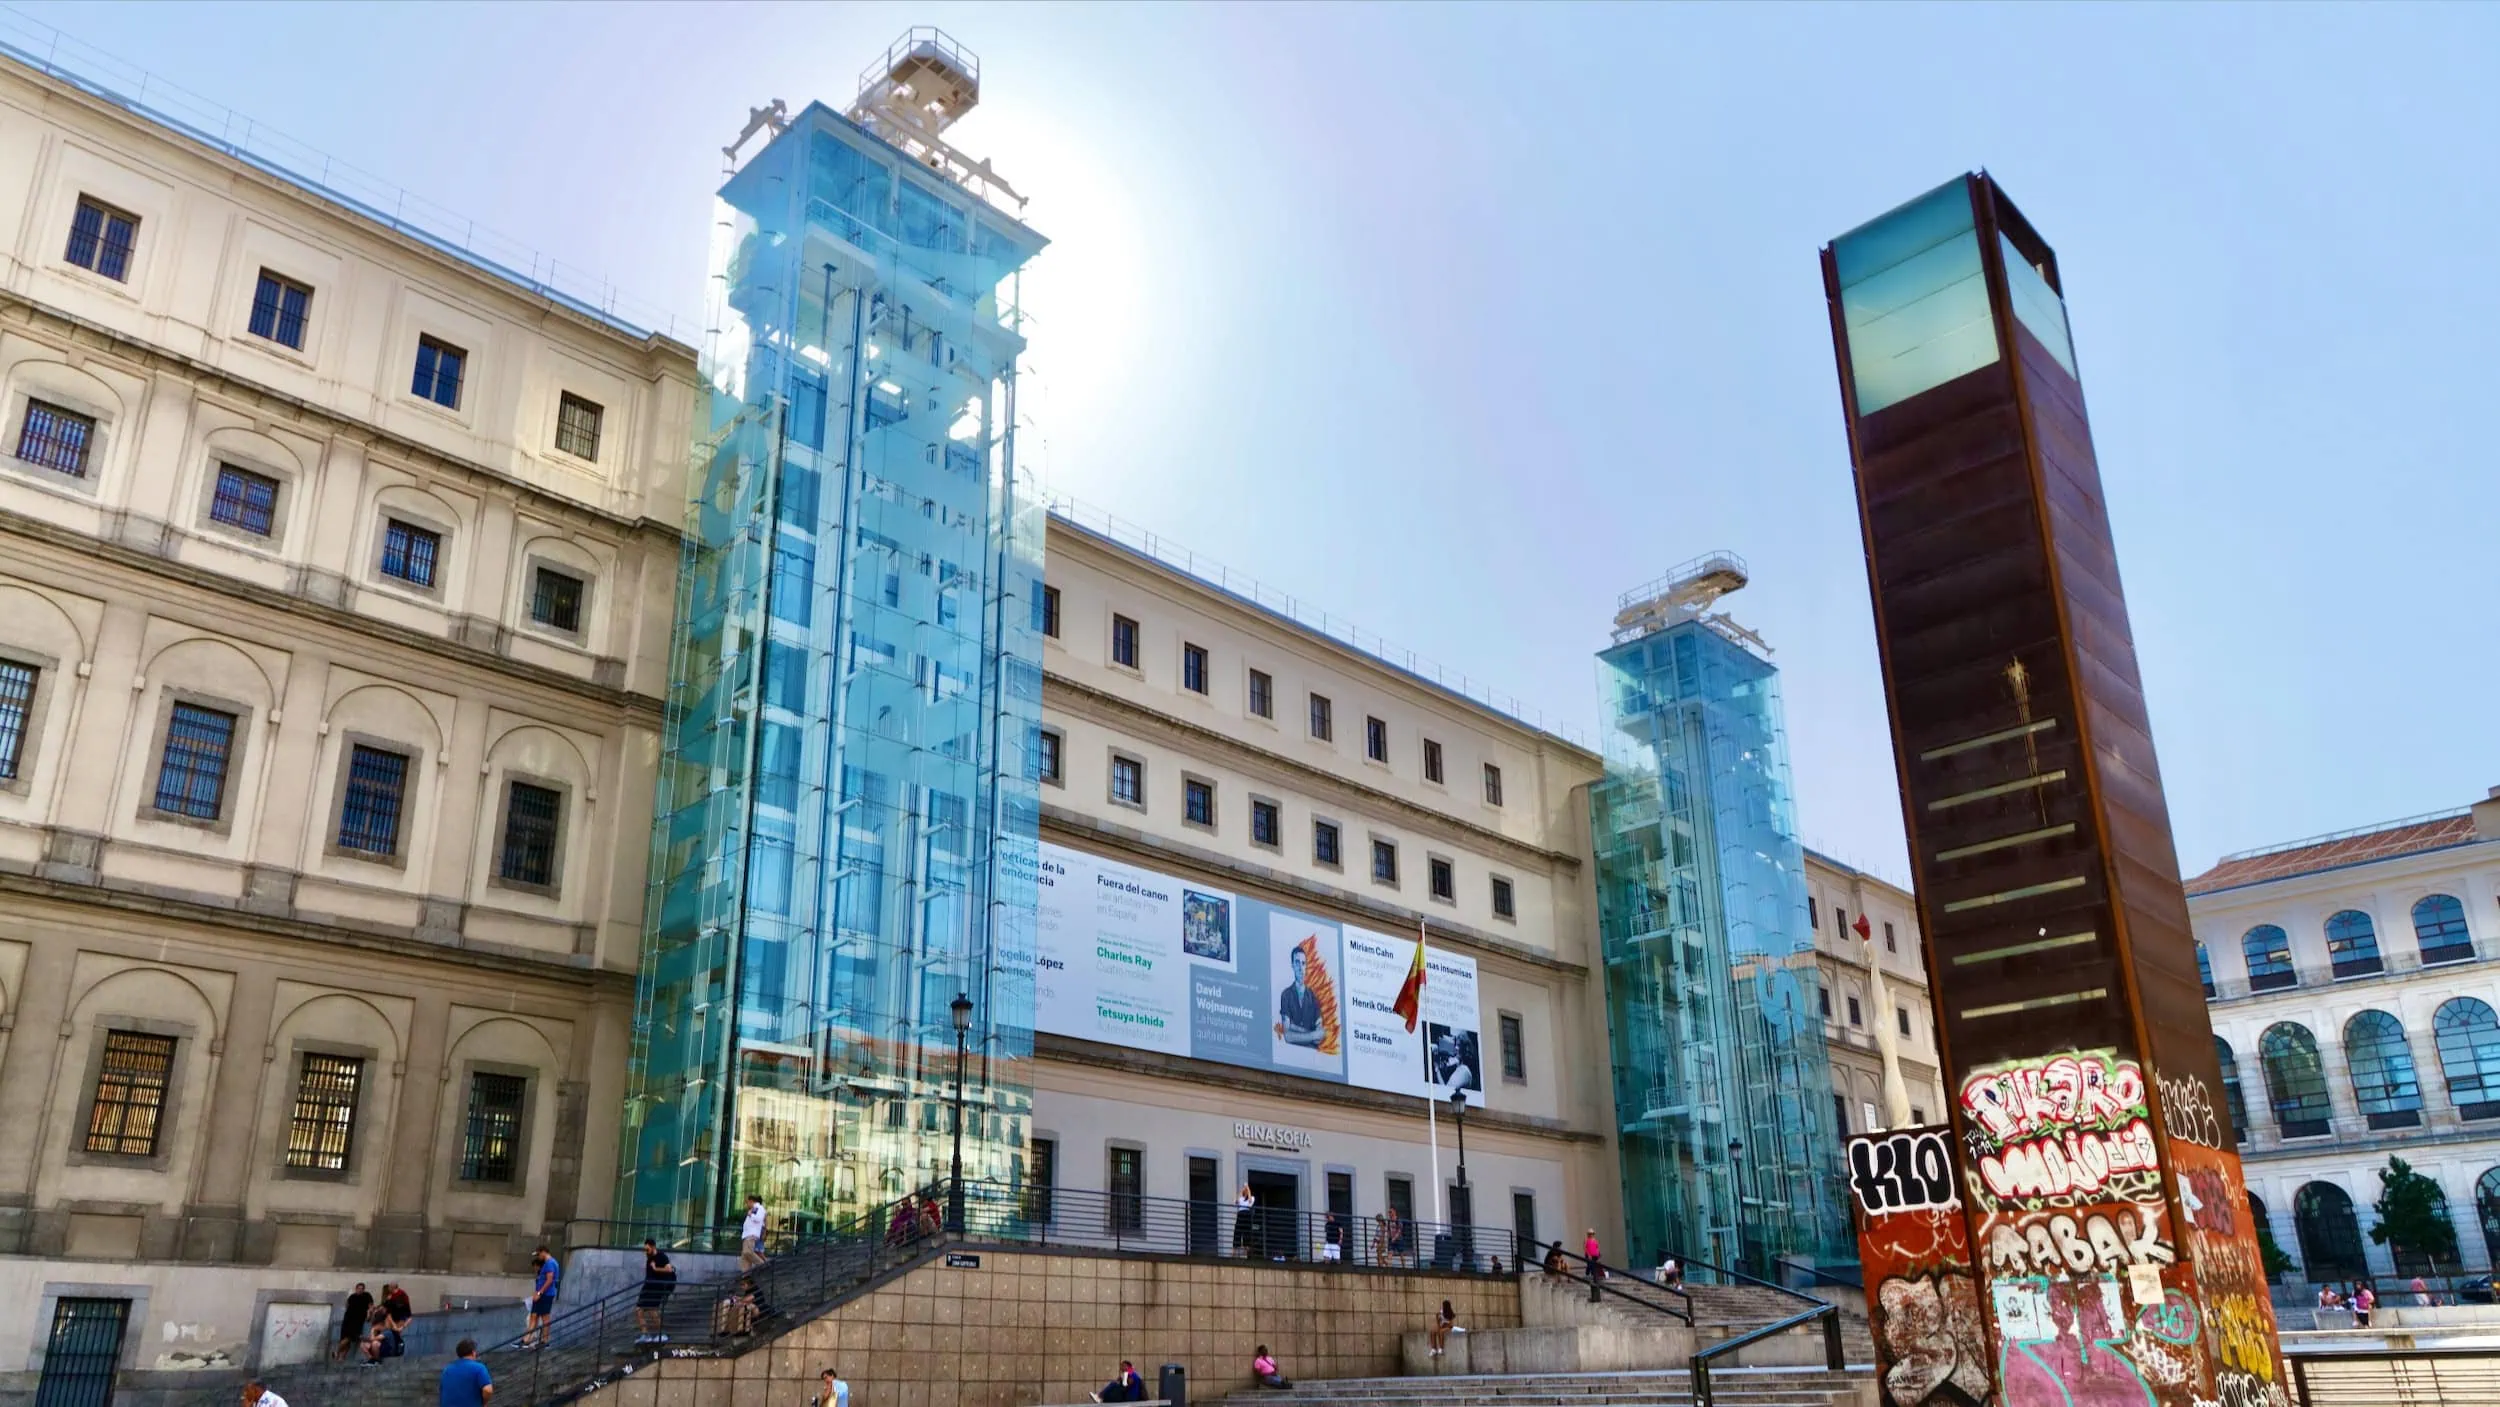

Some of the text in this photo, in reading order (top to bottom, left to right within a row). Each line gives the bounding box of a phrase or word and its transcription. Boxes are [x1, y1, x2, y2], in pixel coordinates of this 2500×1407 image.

[999, 849, 1039, 869] oéticas
[1042, 861, 1055, 873] de
[1056, 864, 1066, 876] la
[1000, 867, 1054, 887] emocracia
[1097, 874, 1124, 891] Fuera
[1125, 881, 1140, 896] del
[1141, 889, 1169, 903] canon
[999, 948, 1032, 964] ogelio
[1035, 953, 1065, 971] López
[1096, 946, 1153, 970] Charles Ray
[1350, 940, 1375, 954] Miriam
[1375, 946, 1394, 960] Cahn
[1440, 962, 1473, 980] insumisas
[1196, 982, 1222, 998] David
[1196, 997, 1254, 1020] Wojnarowicz
[1352, 997, 1395, 1015] Henrik Oles
[1096, 1005, 1134, 1023] Tetsuya
[1136, 1012, 1165, 1028] Ishida
[1354, 1030, 1393, 1046] Sara Ramo
[1233, 1122, 1274, 1142] REINA
